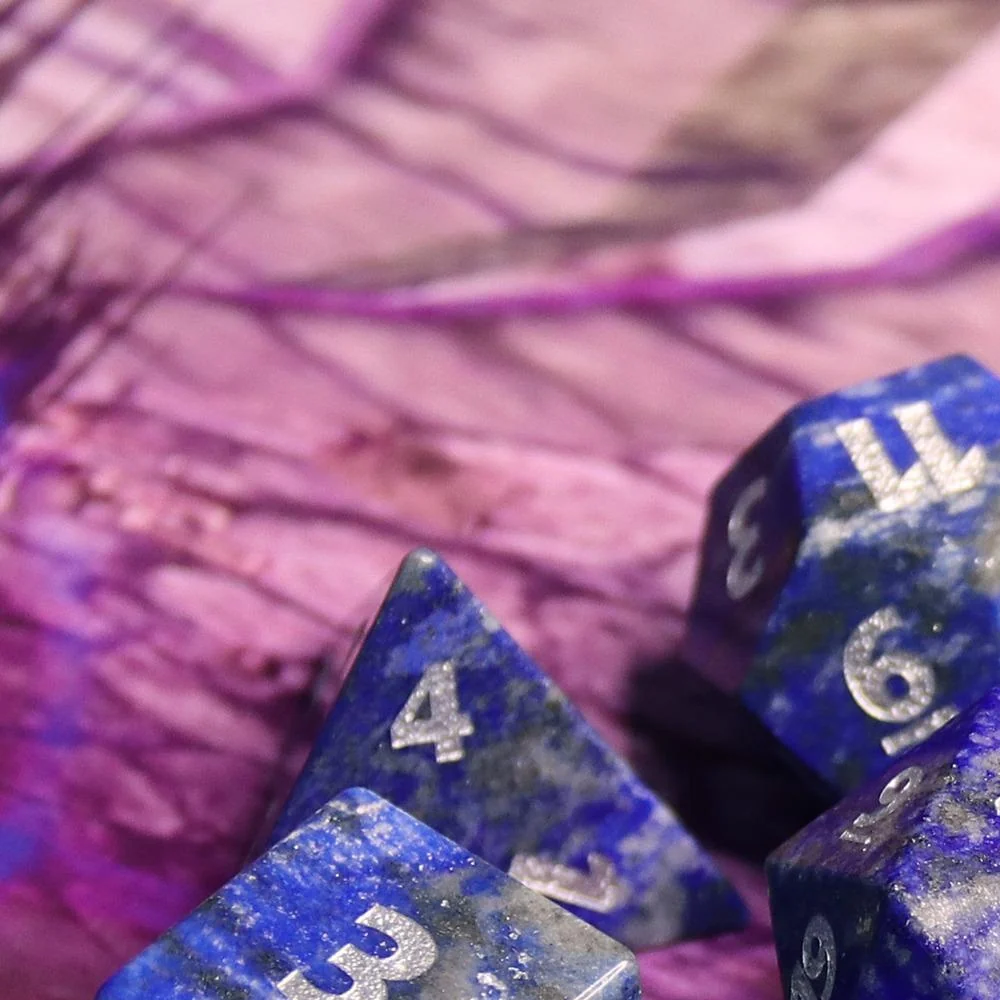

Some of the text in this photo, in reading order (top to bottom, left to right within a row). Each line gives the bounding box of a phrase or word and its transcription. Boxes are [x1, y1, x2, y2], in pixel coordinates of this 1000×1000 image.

[835, 401, 987, 512] 11
[391, 660, 474, 763] 4
[843, 606, 958, 756] 6
